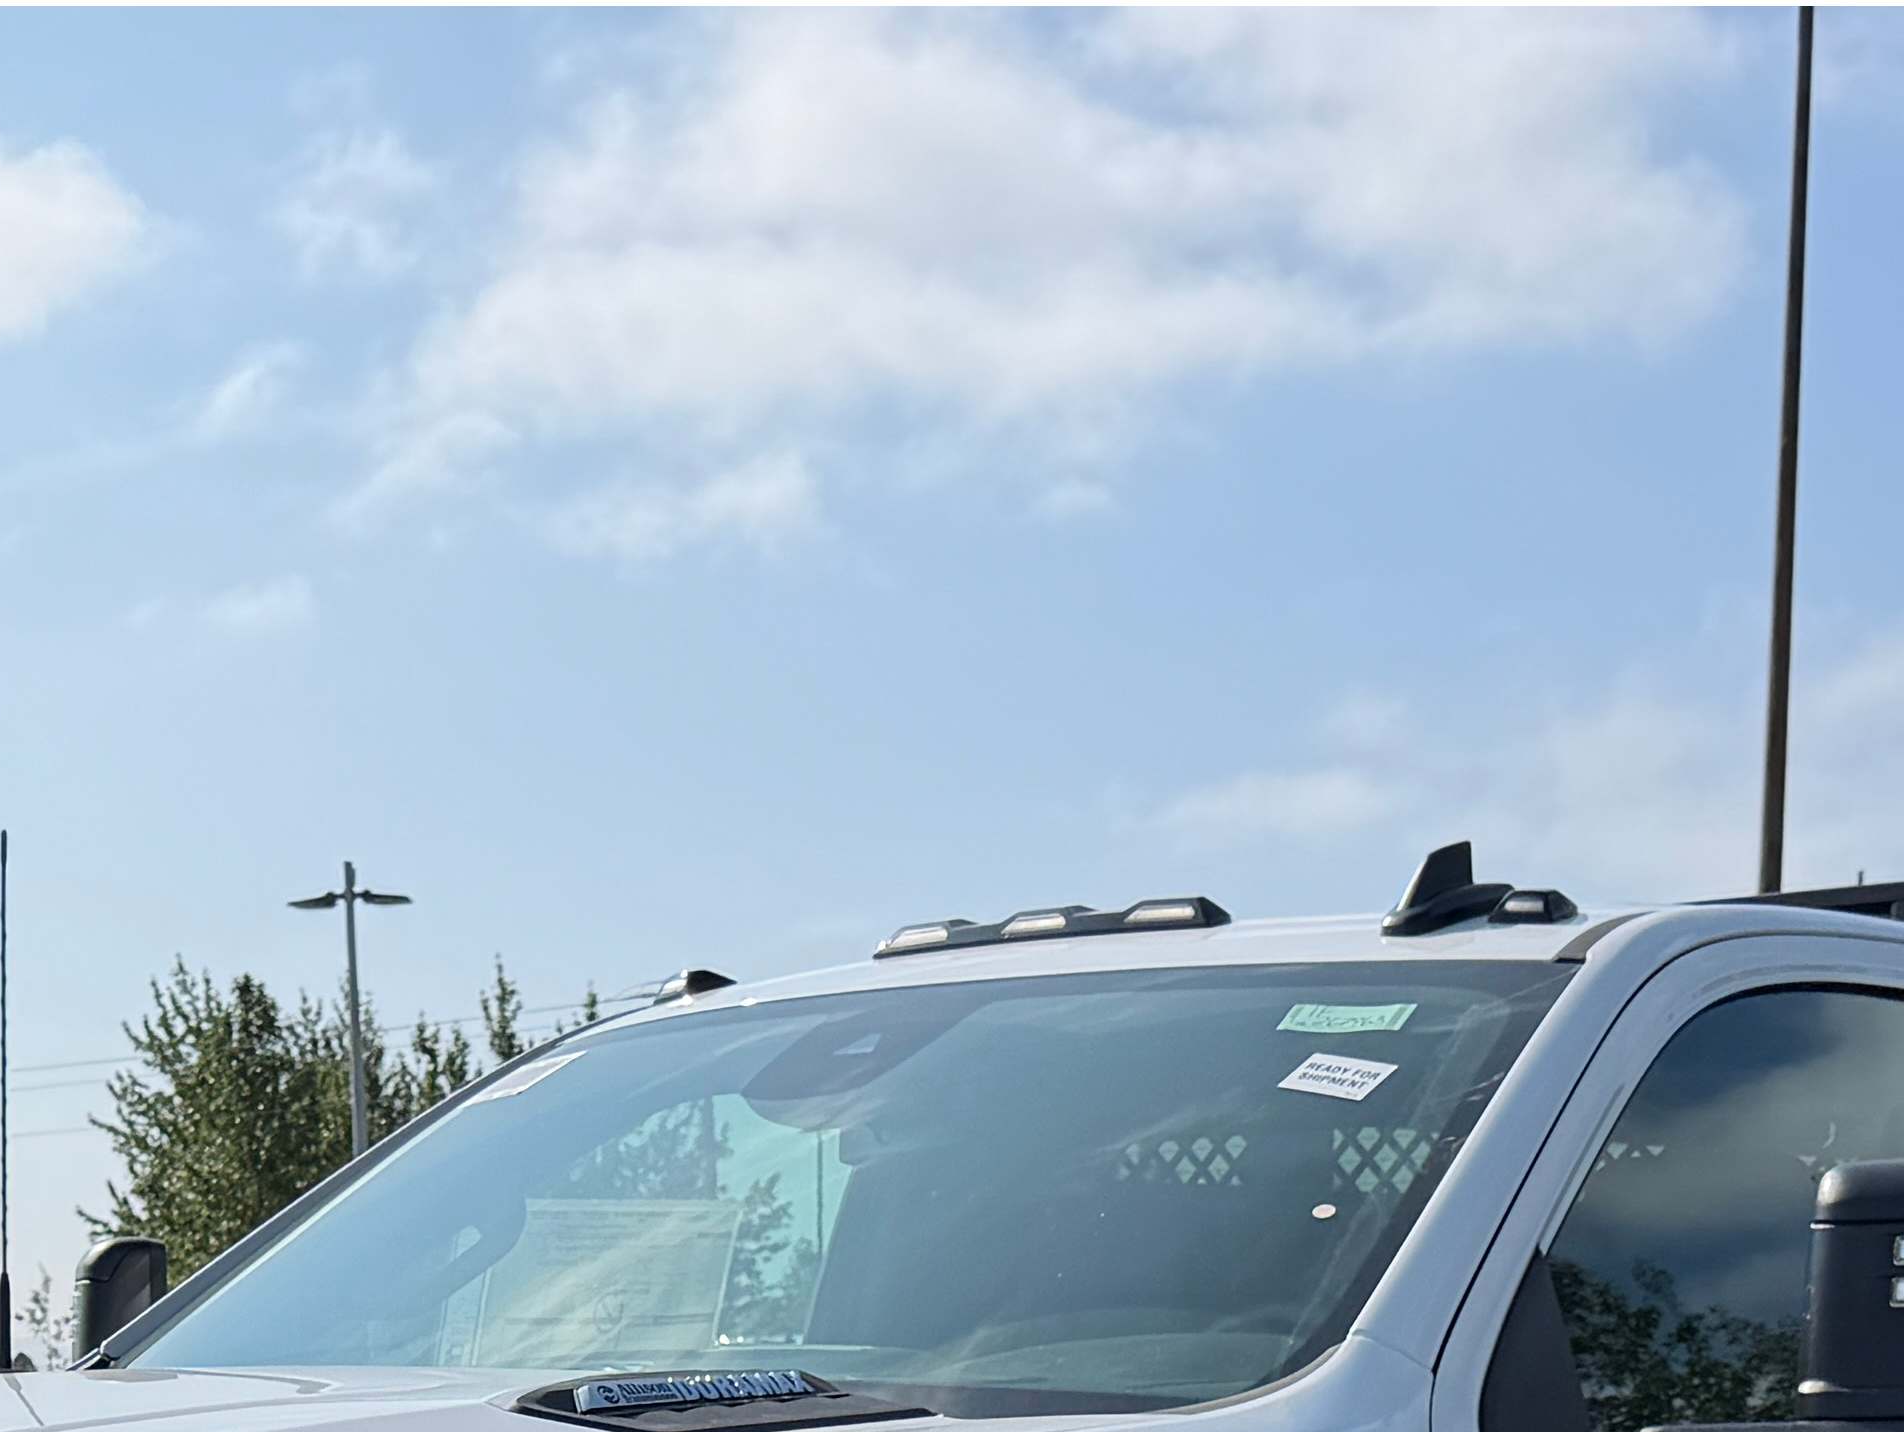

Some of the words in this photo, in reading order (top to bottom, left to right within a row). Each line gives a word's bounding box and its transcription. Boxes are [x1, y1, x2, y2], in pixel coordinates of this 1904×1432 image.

[1298, 1072, 1370, 1090] SHIPMENT
[1304, 1062, 1353, 1076] READY
[1351, 1070, 1381, 1081] FOR
[617, 1382, 674, 1397] Allison
[677, 1372, 815, 1400] DURAMAX
